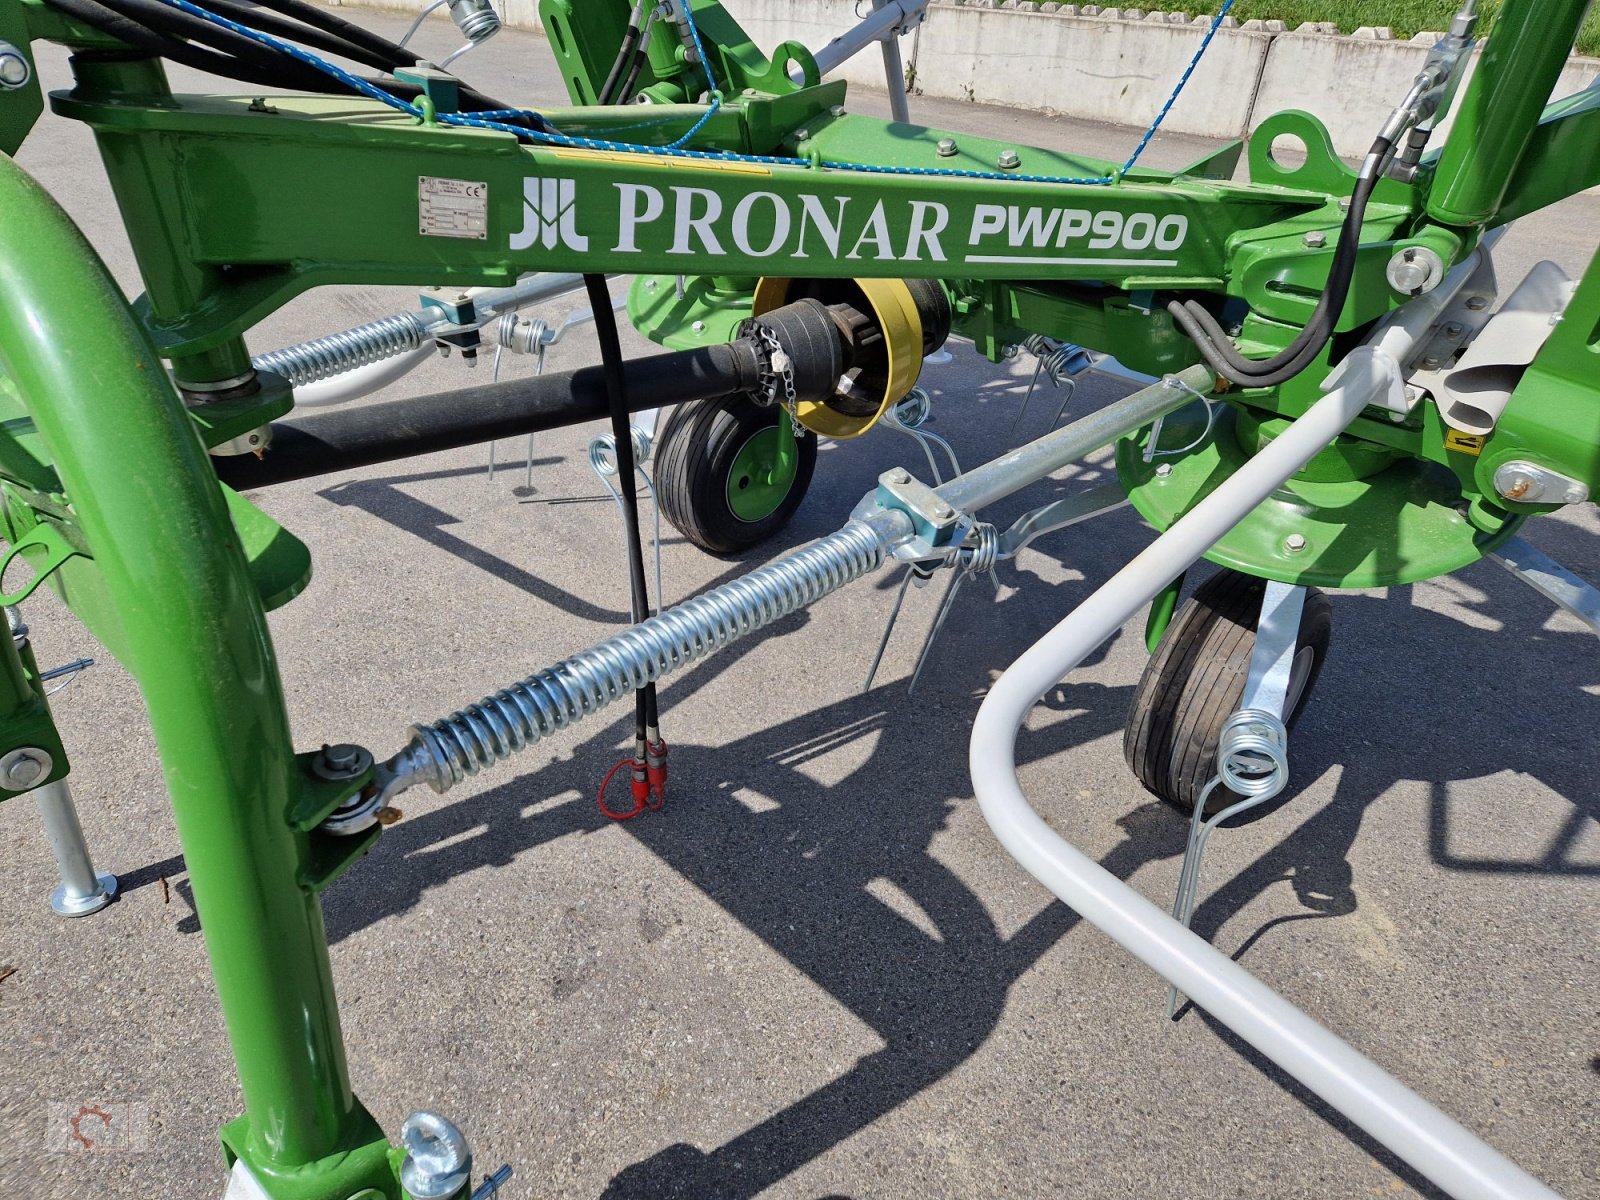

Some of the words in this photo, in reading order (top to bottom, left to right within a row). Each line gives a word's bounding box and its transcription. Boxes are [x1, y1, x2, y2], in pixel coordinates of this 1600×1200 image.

[466, 186, 480, 197] CE
[610, 182, 948, 262] PRONAR
[968, 203, 1188, 251] PWP900
